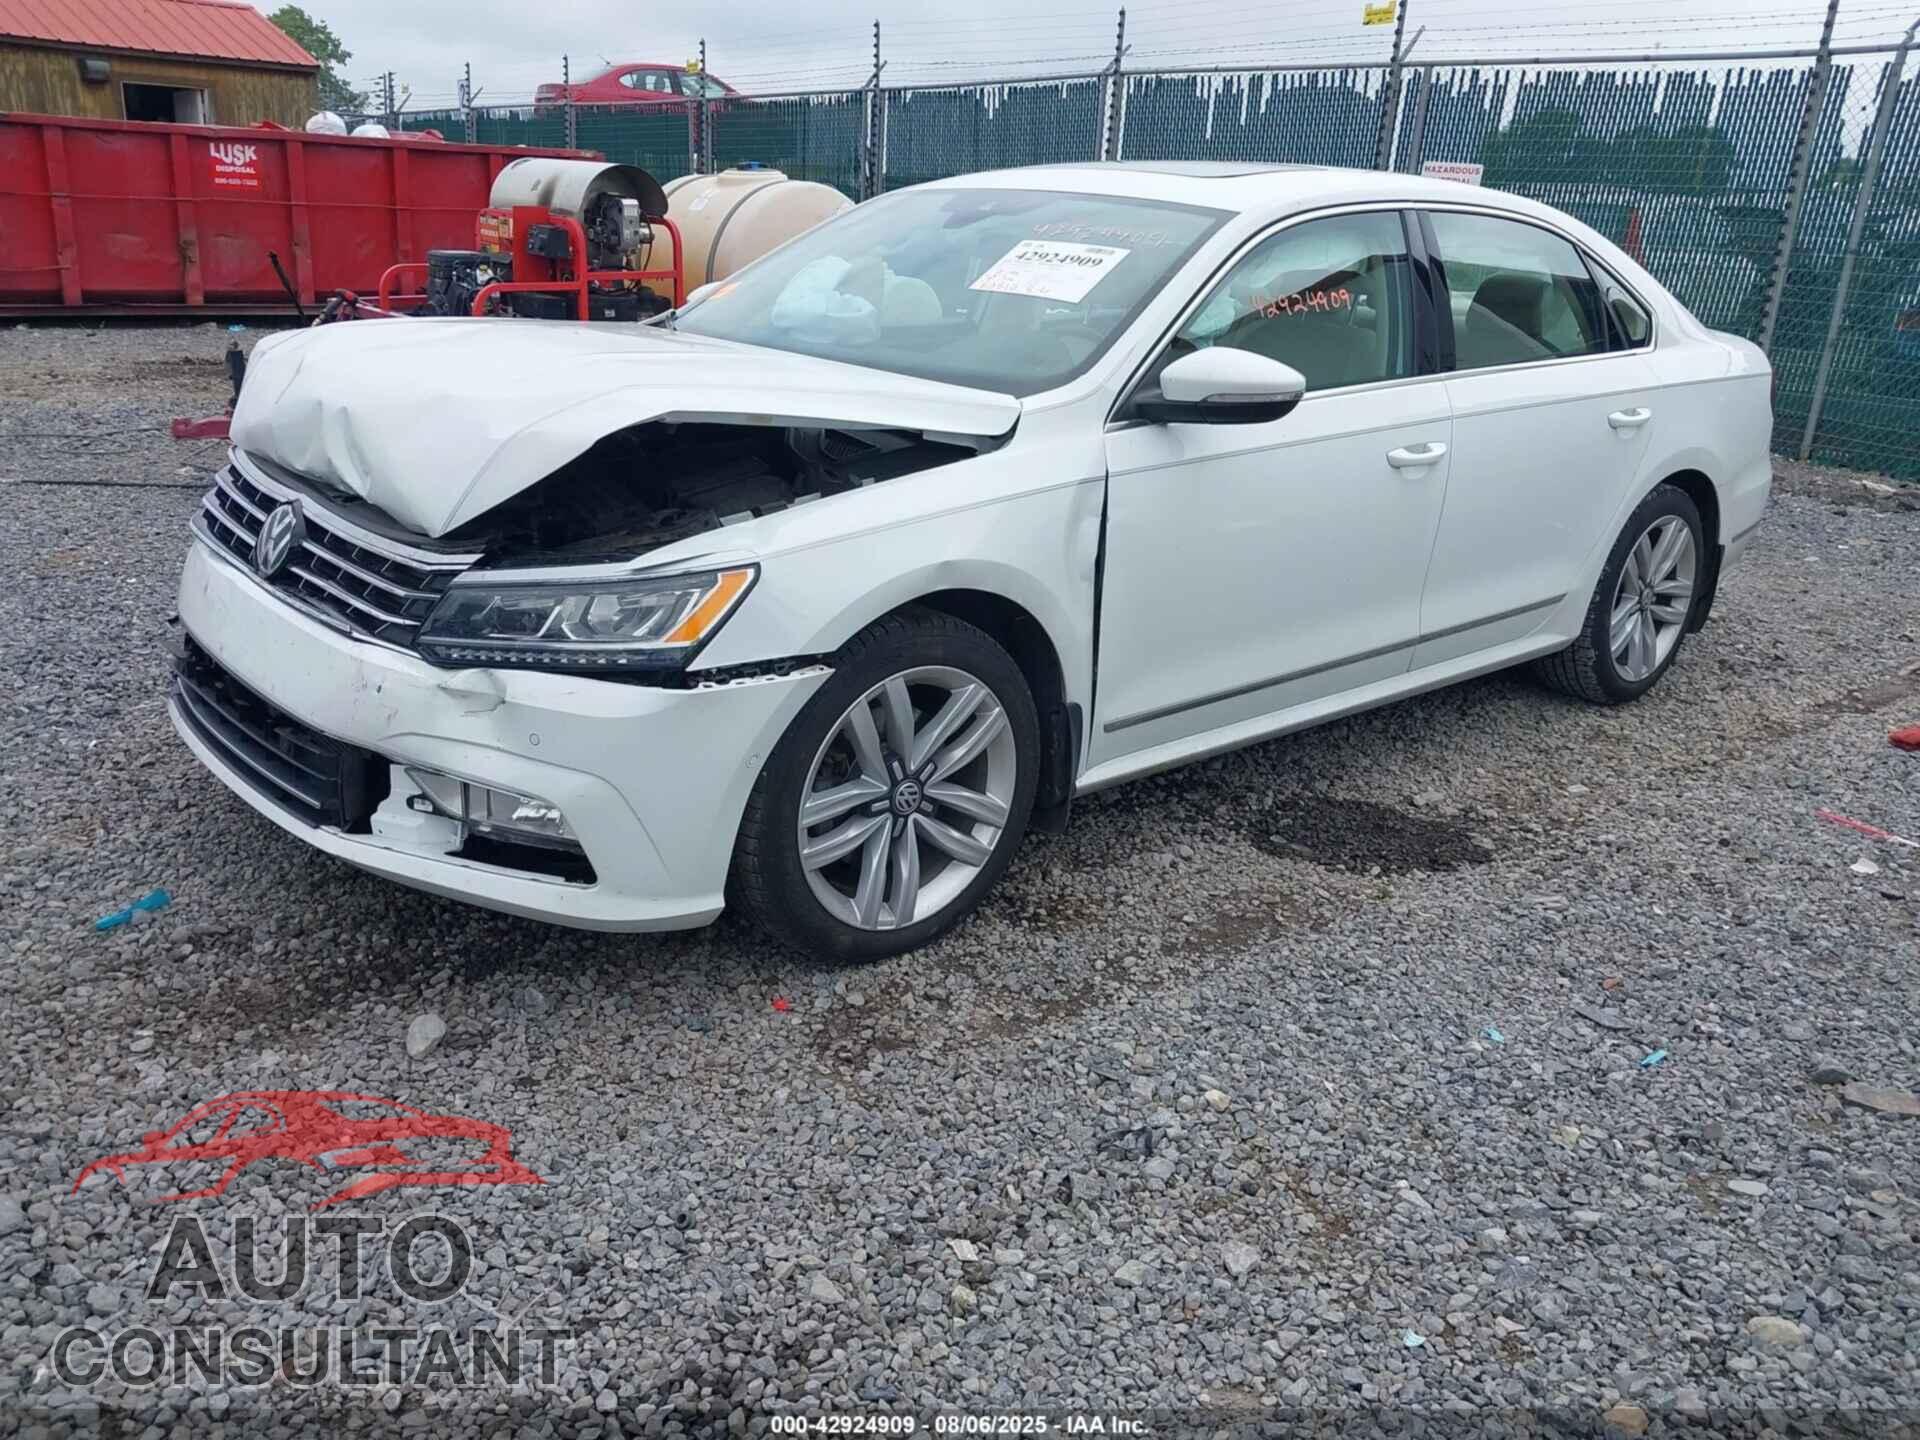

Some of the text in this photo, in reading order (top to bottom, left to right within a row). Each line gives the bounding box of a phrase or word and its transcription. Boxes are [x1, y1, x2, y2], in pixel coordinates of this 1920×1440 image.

[209, 142, 257, 166] LUSK
[215, 165, 256, 174] DISPOSAL
[1424, 165, 1480, 176] HAZARDOUS
[1015, 251, 1103, 268] 42924909
[1250, 288, 1351, 318] 42924909
